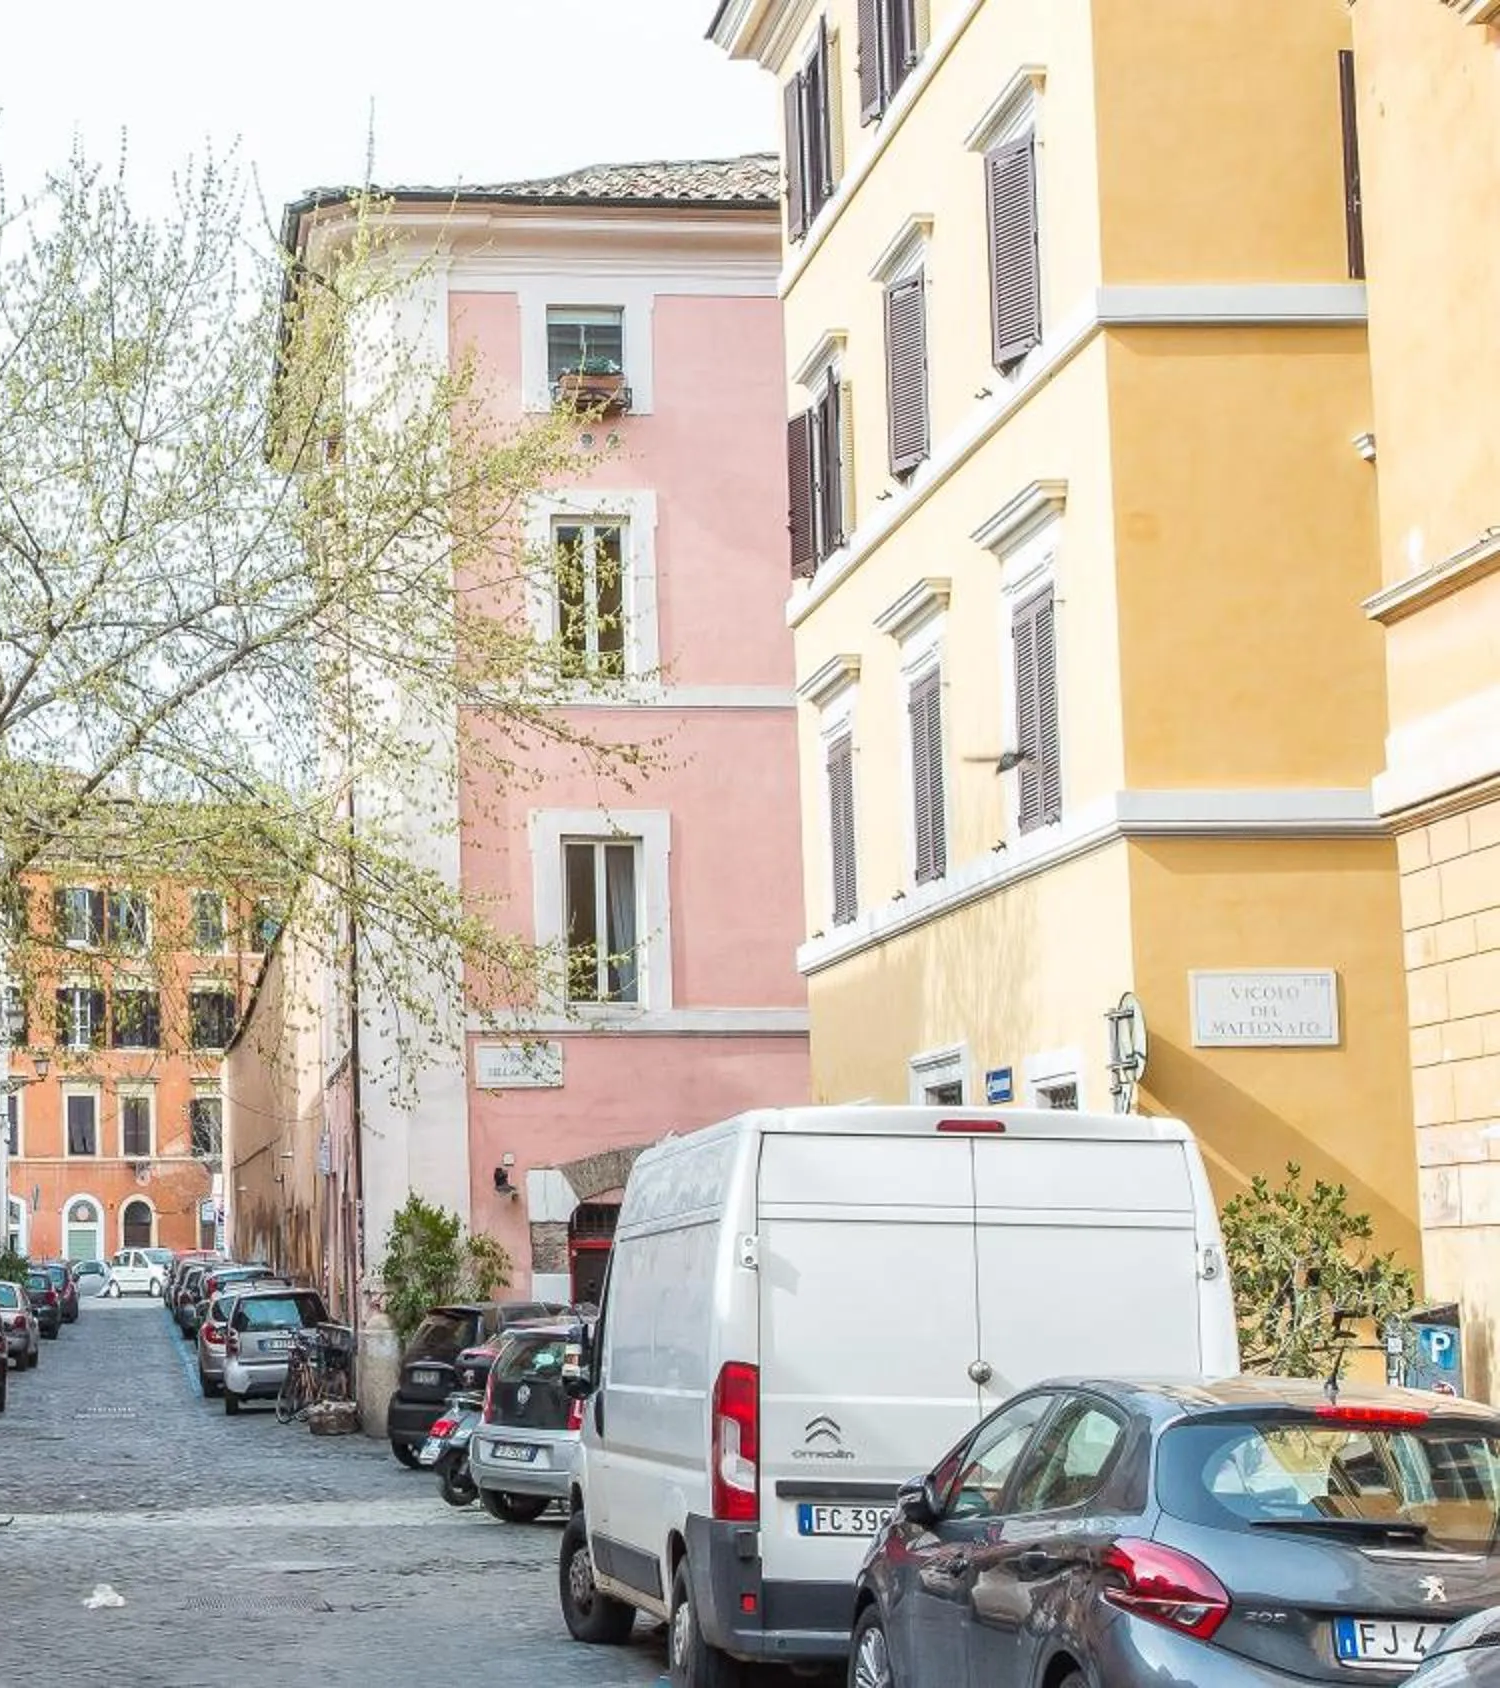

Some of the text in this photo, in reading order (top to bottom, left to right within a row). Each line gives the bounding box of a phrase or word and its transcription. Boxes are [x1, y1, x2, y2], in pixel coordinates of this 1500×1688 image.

[1231, 986, 1300, 1000] VICOLO
[1251, 1006, 1278, 1017] DEL
[1212, 1022, 1320, 1035] MATTONATO
[1430, 1332, 1451, 1363] P
[815, 1508, 842, 1531] FC
[1359, 1624, 1398, 1654] FJ
